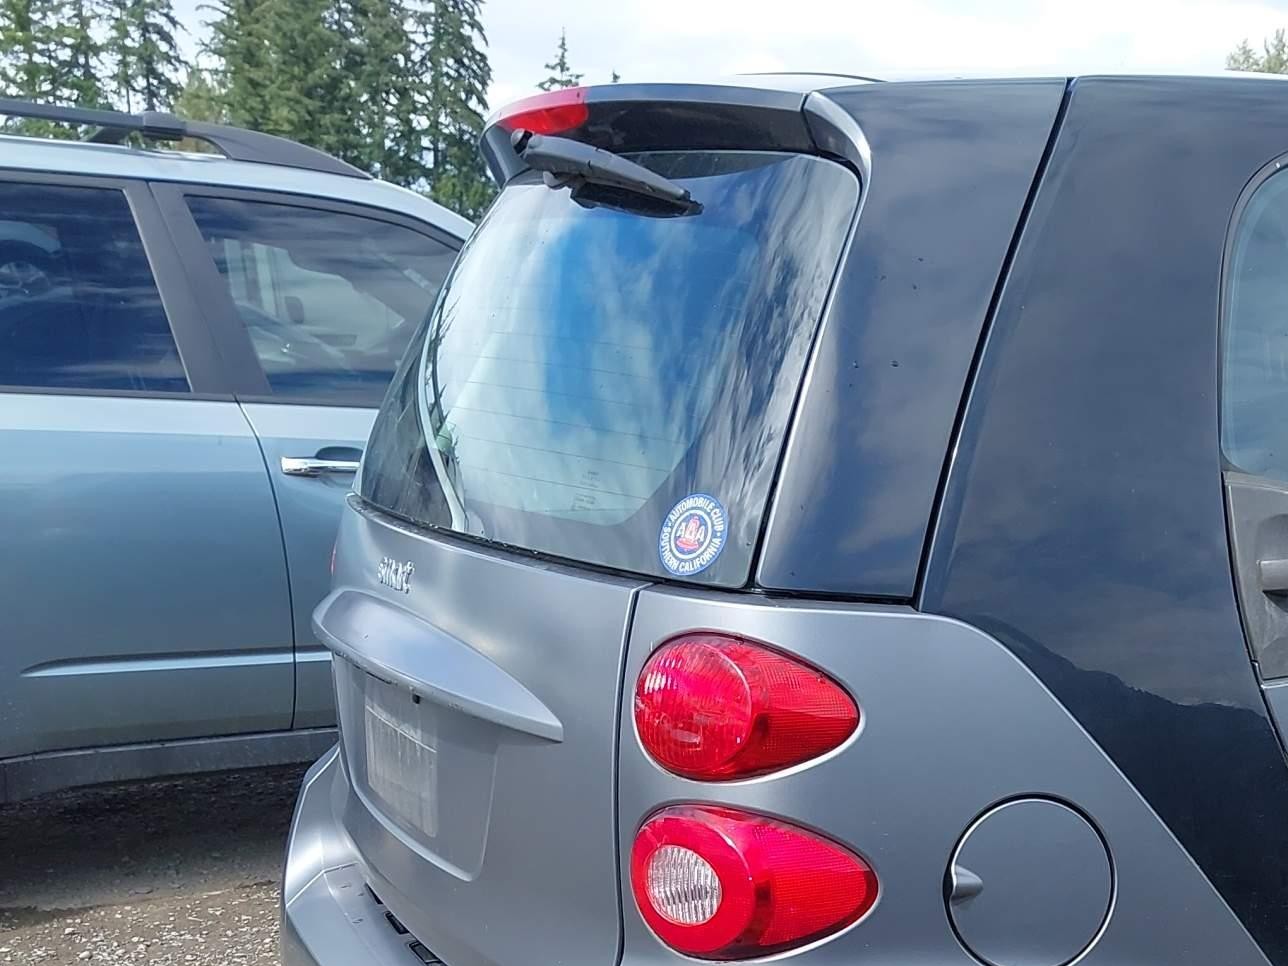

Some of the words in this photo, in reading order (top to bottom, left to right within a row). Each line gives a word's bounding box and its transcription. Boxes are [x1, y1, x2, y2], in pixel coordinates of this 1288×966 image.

[669, 497, 715, 523] AUTOMOBILE
[711, 508, 724, 532] CLUB
[676, 521, 705, 542] AAA
[661, 526, 680, 571] SOUTHERN
[679, 538, 721, 573] CALIFORNIA
